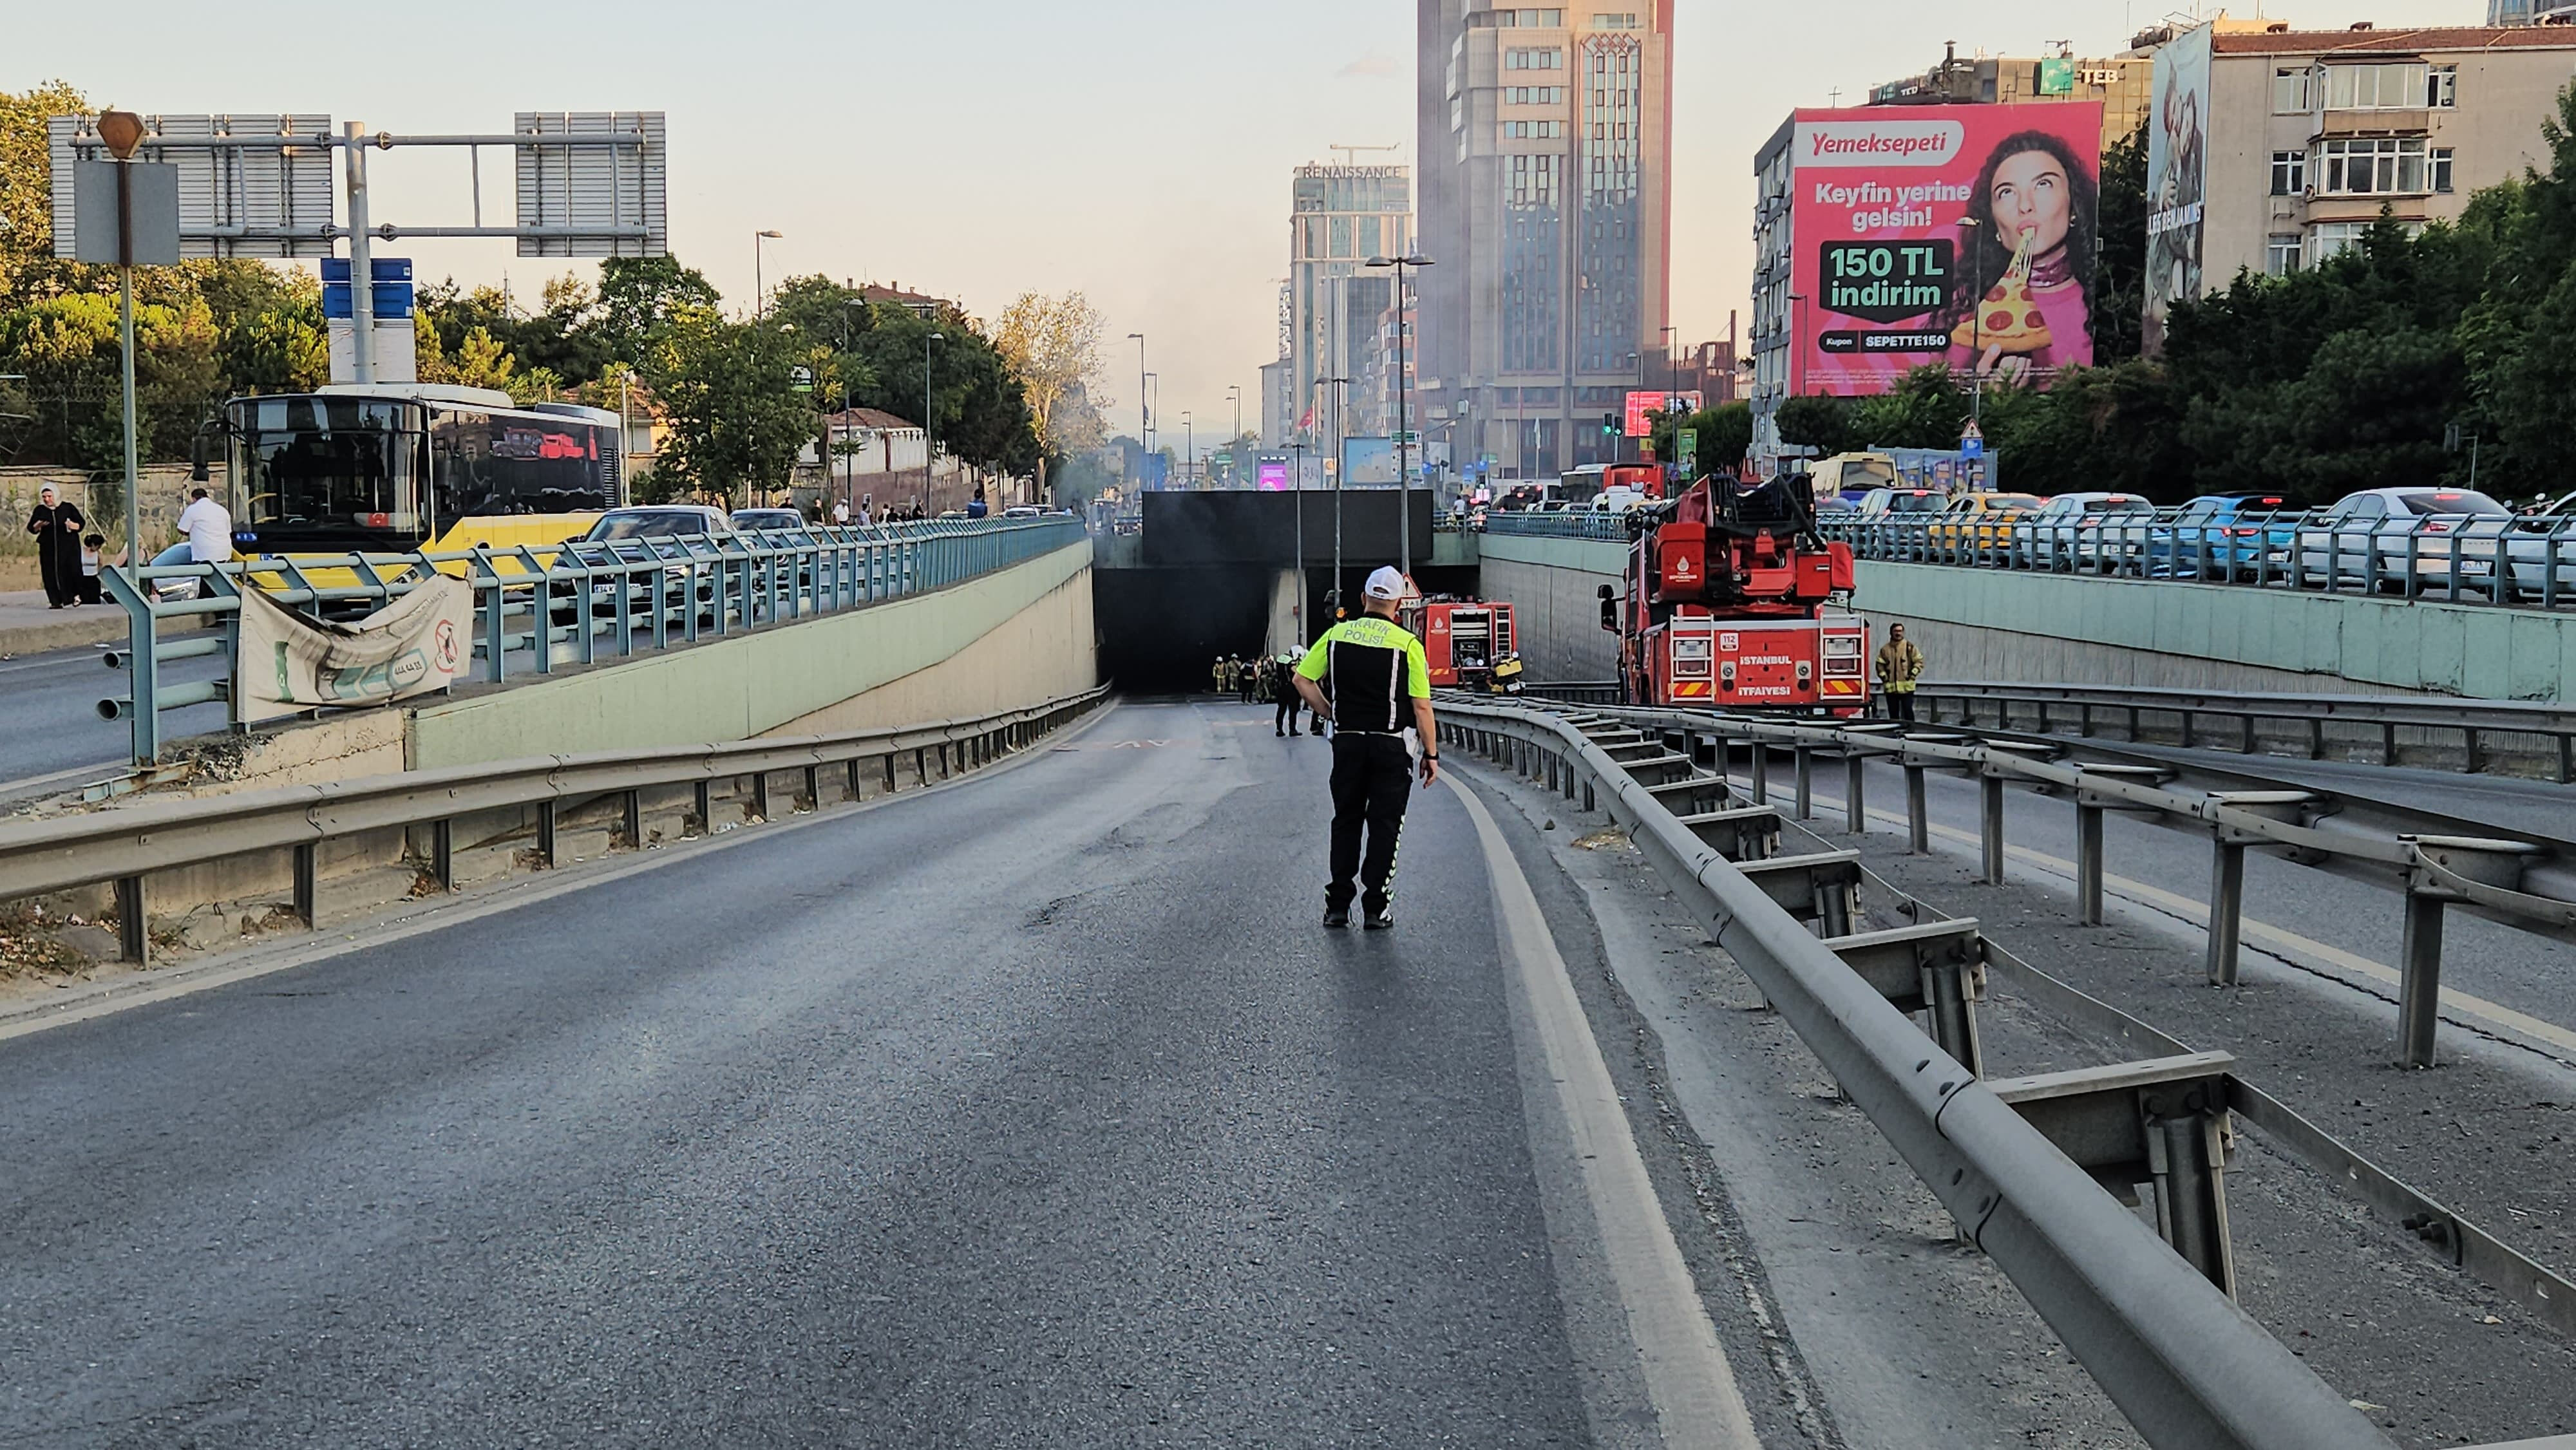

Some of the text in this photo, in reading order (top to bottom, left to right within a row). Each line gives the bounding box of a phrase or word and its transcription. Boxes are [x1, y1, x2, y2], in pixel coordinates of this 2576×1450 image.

[2081, 69, 2119, 83] TEB
[1812, 132, 1946, 156] Yemeksepeti
[1303, 166, 1400, 179] RENAISSANCE
[1815, 180, 1971, 207] Keyfin yerine
[1853, 206, 1932, 232] gelsin!
[1830, 247, 1944, 277] 150 TL
[1831, 279, 1941, 306] indirim
[1826, 334, 1946, 348] Kupon SEPETTE150
[1343, 629, 1385, 645] POLİSİ
